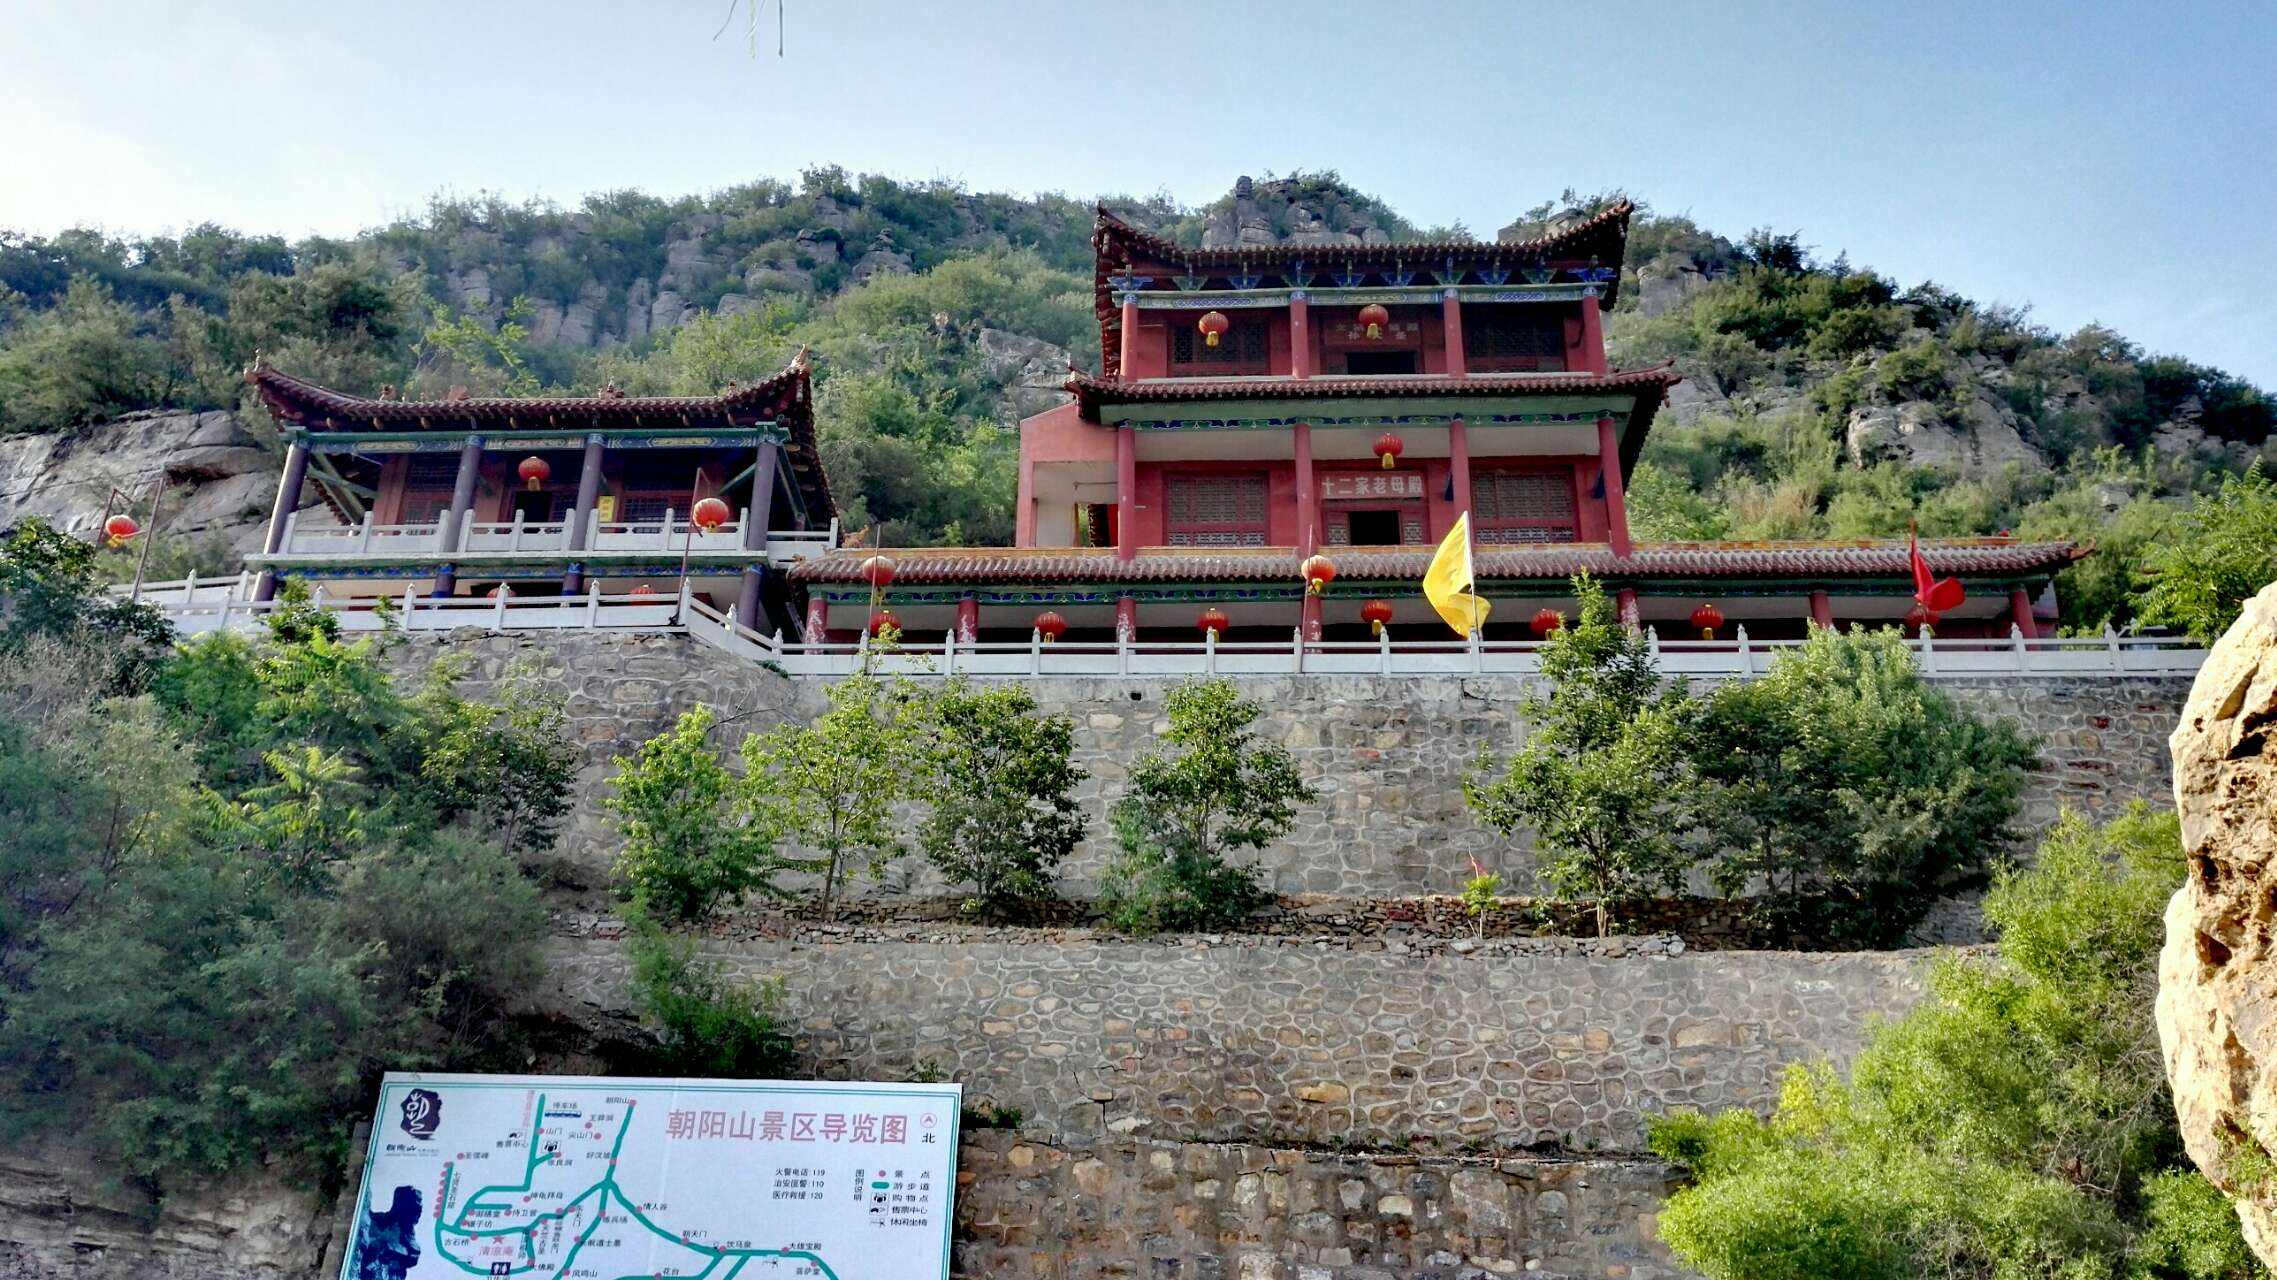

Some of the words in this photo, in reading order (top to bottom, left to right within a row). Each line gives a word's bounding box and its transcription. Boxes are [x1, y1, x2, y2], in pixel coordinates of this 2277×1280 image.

[1321, 475, 1423, 496] 十二家老母殿
[545, 1127, 562, 1135] 山门
[665, 1108, 909, 1145] 朝阳山景区导览图
[921, 1132, 936, 1144] 北
[813, 1169, 826, 1177] 119
[811, 1180, 825, 1188] 110
[810, 1191, 823, 1200] 120
